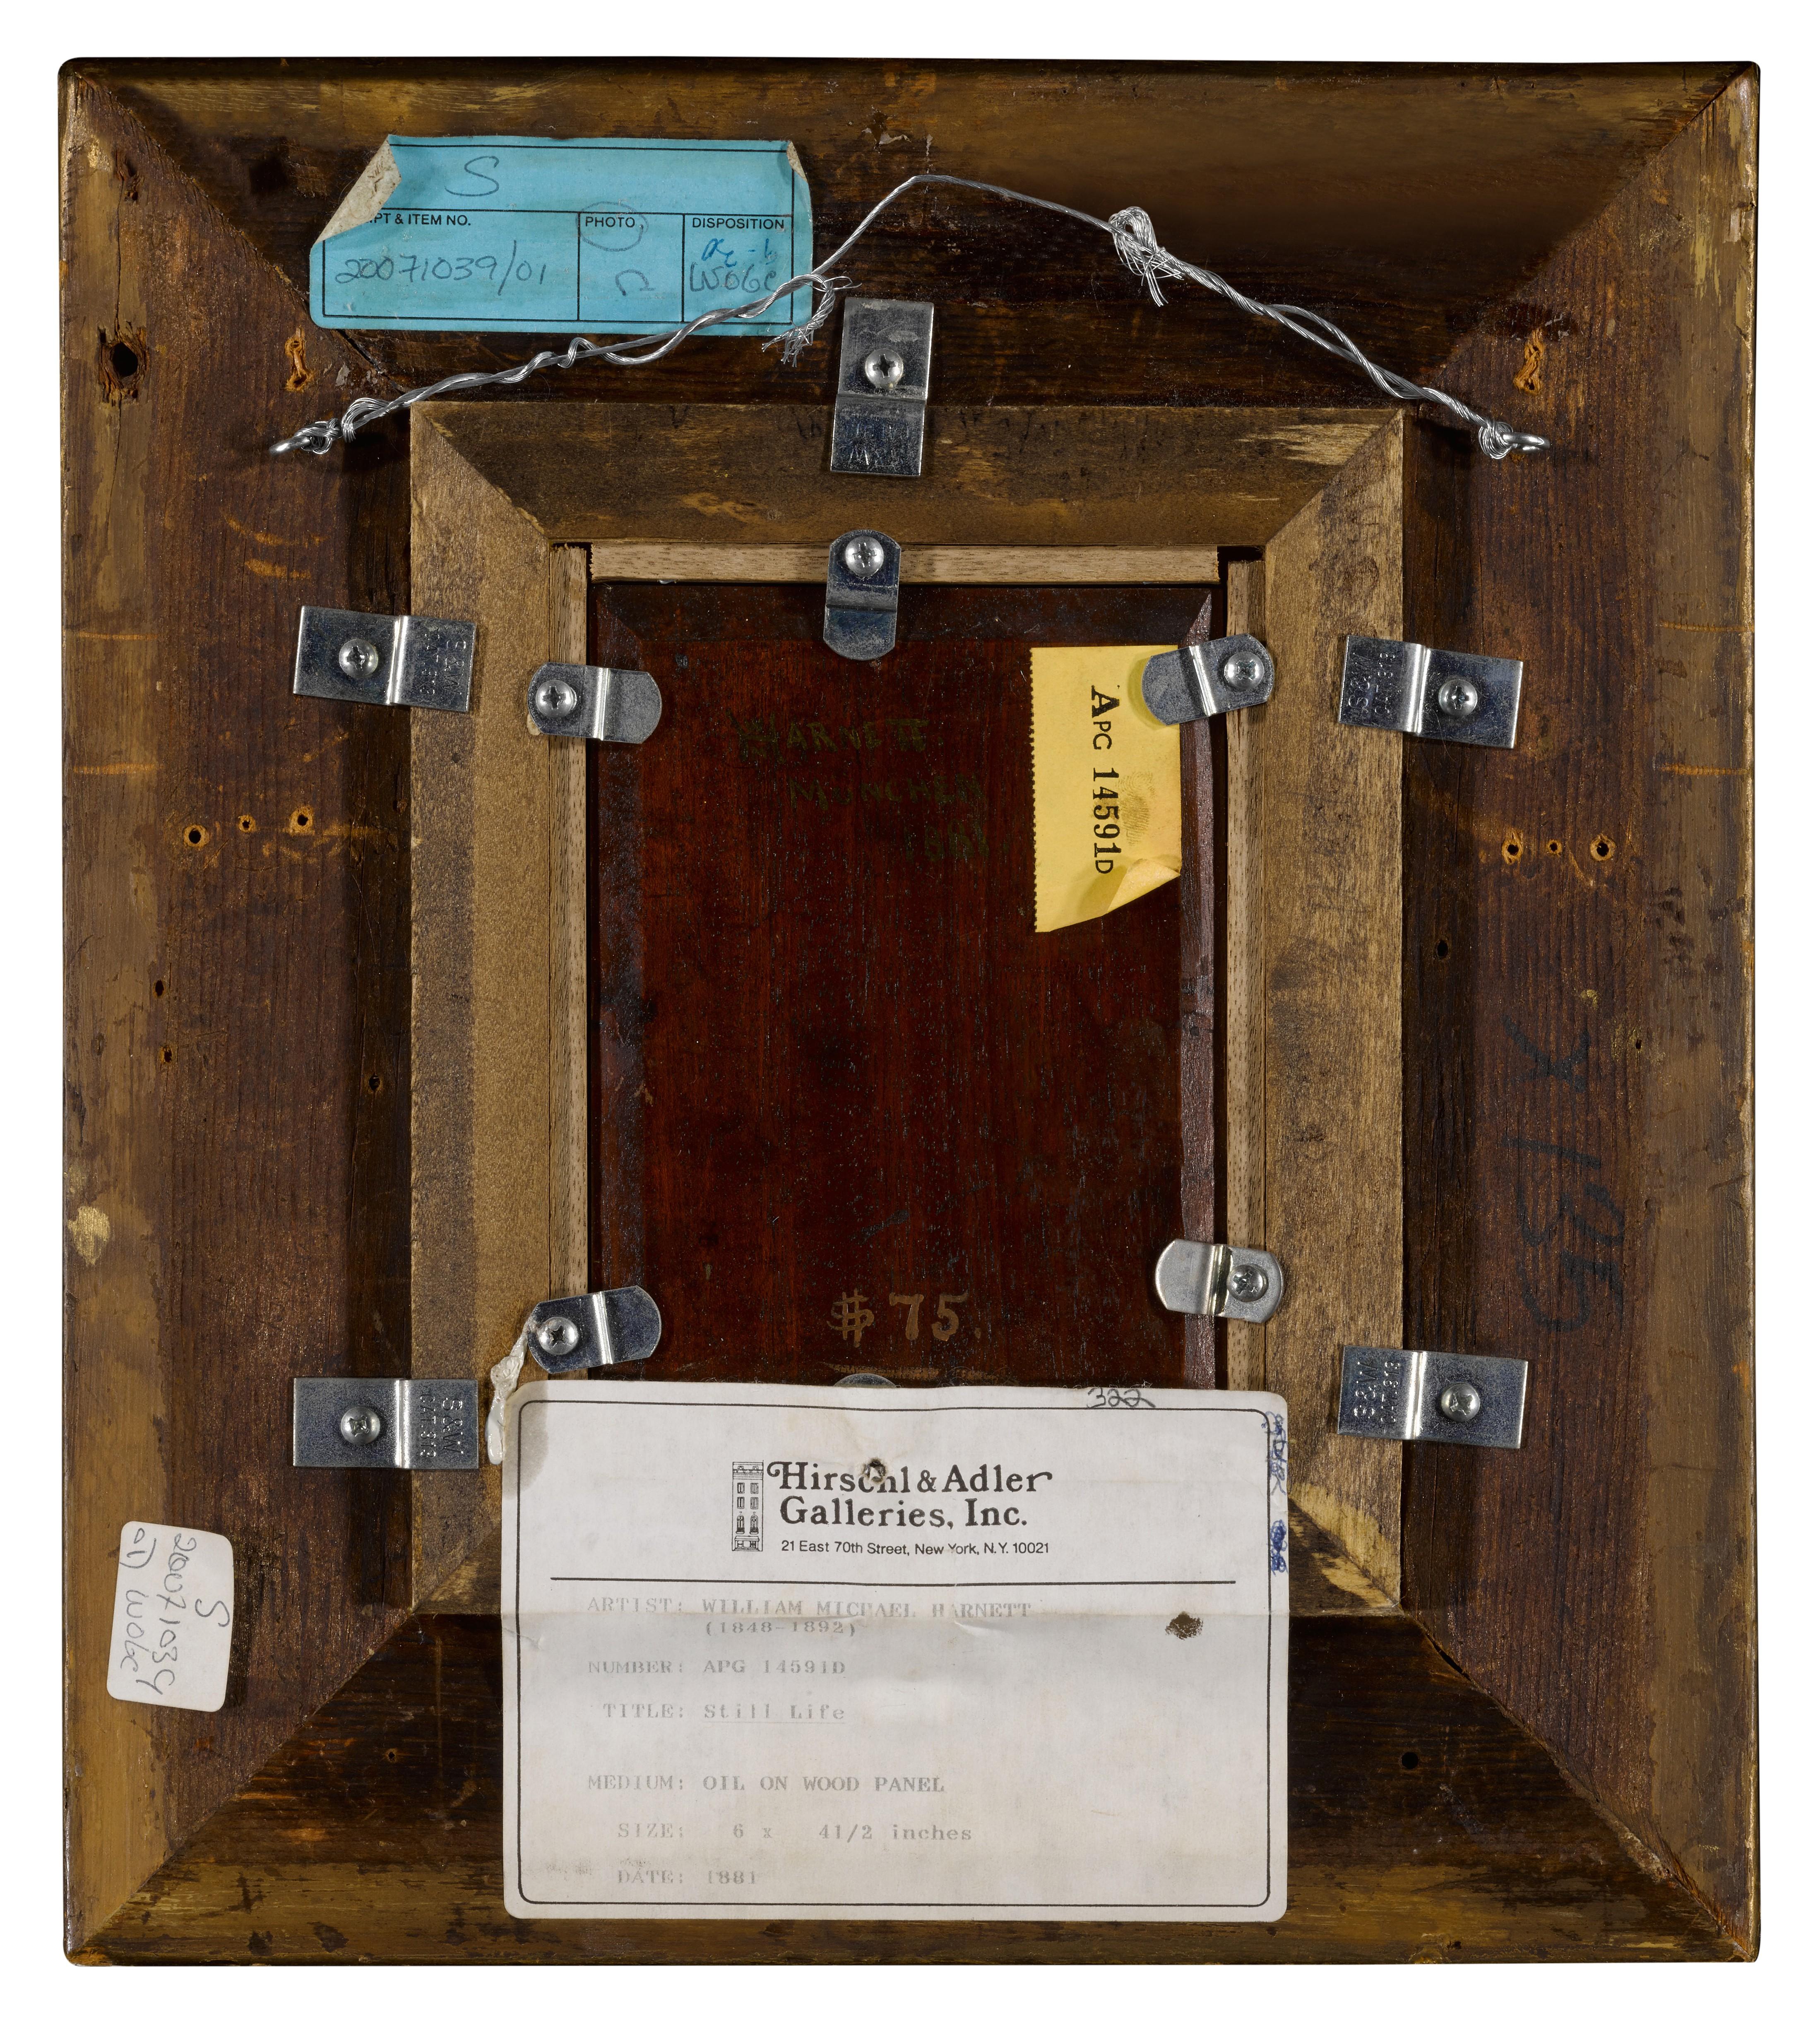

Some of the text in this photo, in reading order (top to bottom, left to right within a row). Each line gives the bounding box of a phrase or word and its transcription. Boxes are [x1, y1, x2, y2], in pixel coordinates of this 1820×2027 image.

[445, 156, 500, 197] S
[395, 214, 404, 224] &
[408, 214, 442, 226] ITEM
[447, 215, 471, 226] NO.
[585, 217, 635, 228] PHOTO
[692, 218, 784, 230] DISPOSITION
[941, 1463, 1053, 1493] Adler
[780, 1496, 1028, 1529] Galleries, Inc.
[781, 1540, 795, 1552] 21
[799, 1540, 829, 1553] East
[834, 1541, 863, 1554] 70th
[867, 1542, 910, 1556] Street,
[915, 1543, 944, 1555] New
[947, 1542, 980, 1555] York,
[1012, 1542, 1049, 1554] 10021
[195, 1598, 231, 1627] S
[587, 1597, 683, 1614] ARTIST:
[702, 1599, 803, 1615] WILLIAM
[705, 1620, 856, 1637] (1848-1892)
[587, 1660, 847, 1675] NUMBER: APG 14591D
[603, 1703, 846, 1720] TITLE: Still Life
[588, 1775, 945, 1792] MEDIUM: OIL ON WOOD PANEL
[617, 1823, 684, 1839] SIZE:
[733, 1825, 744, 1839] 6
[762, 1828, 773, 1839] x
[892, 1825, 973, 1841] inches
[617, 1869, 684, 1885] DATE:
